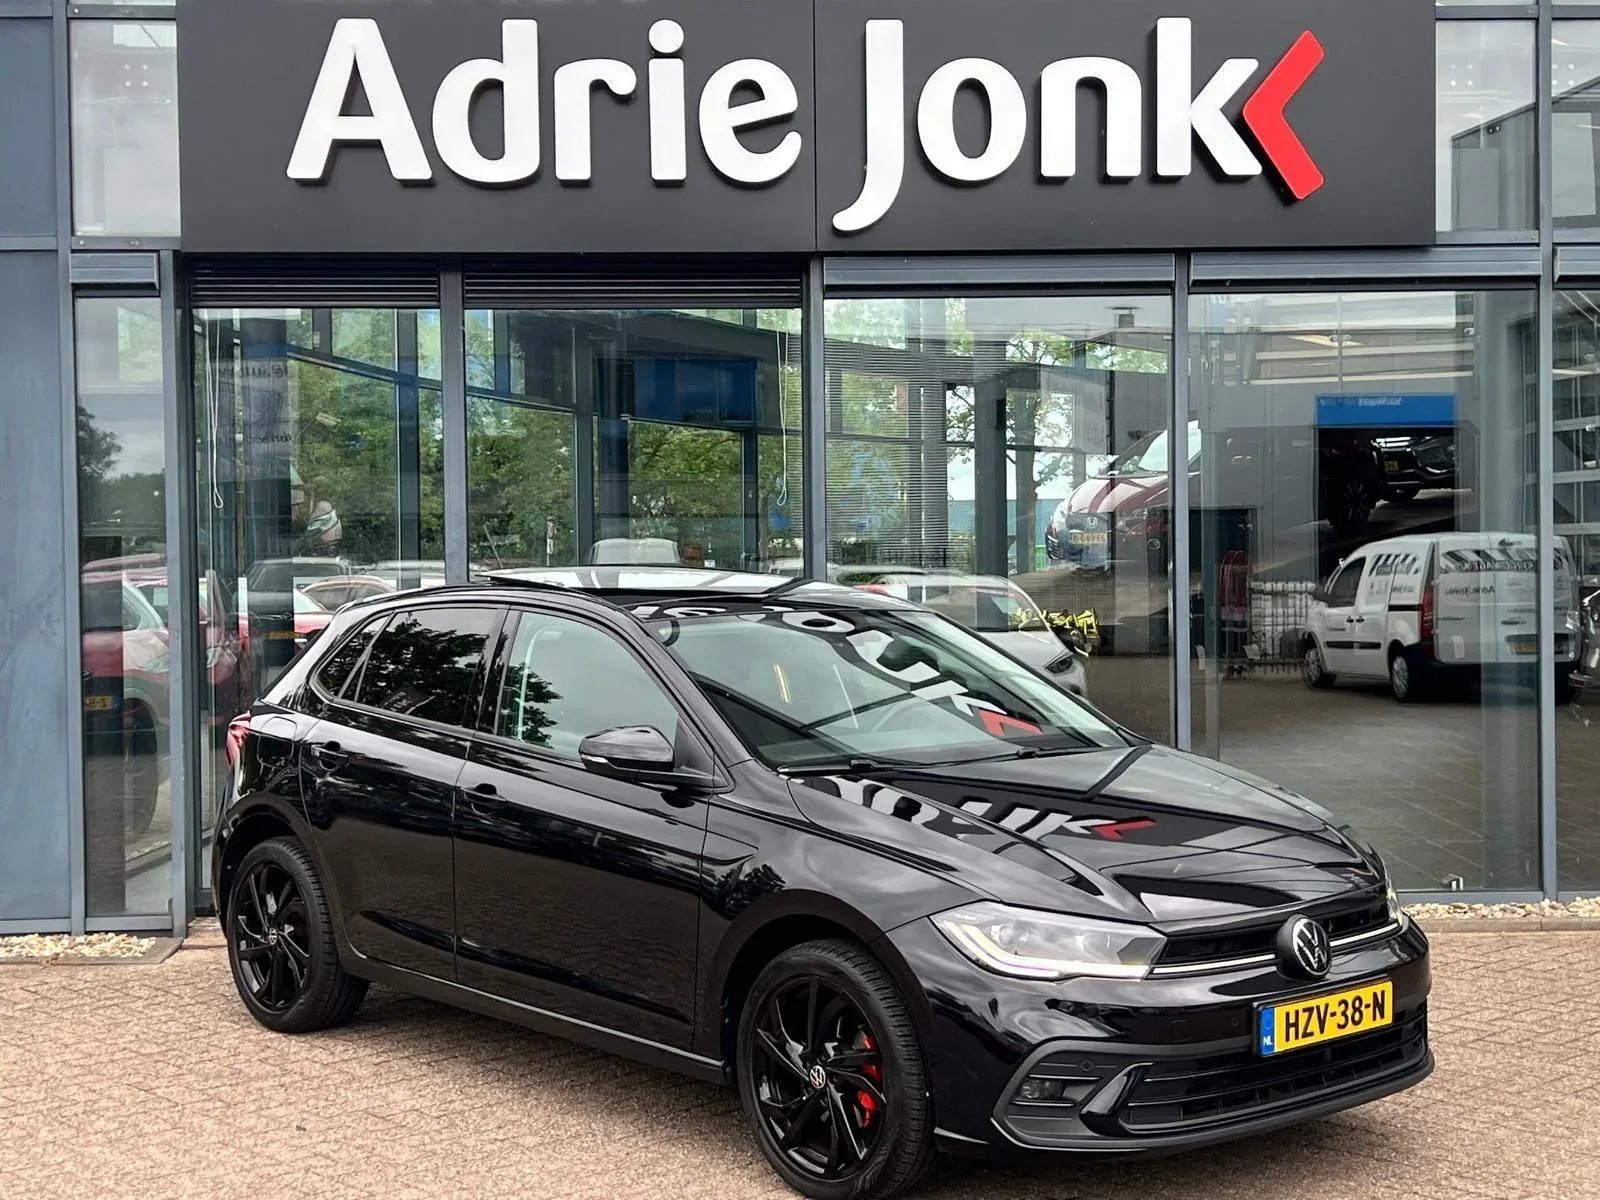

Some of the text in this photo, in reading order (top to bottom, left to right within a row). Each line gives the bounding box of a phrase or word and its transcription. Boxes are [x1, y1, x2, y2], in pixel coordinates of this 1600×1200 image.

[286, 17, 1263, 231] Adrie Jonk
[1285, 989, 1386, 1043] HZV-38-N
